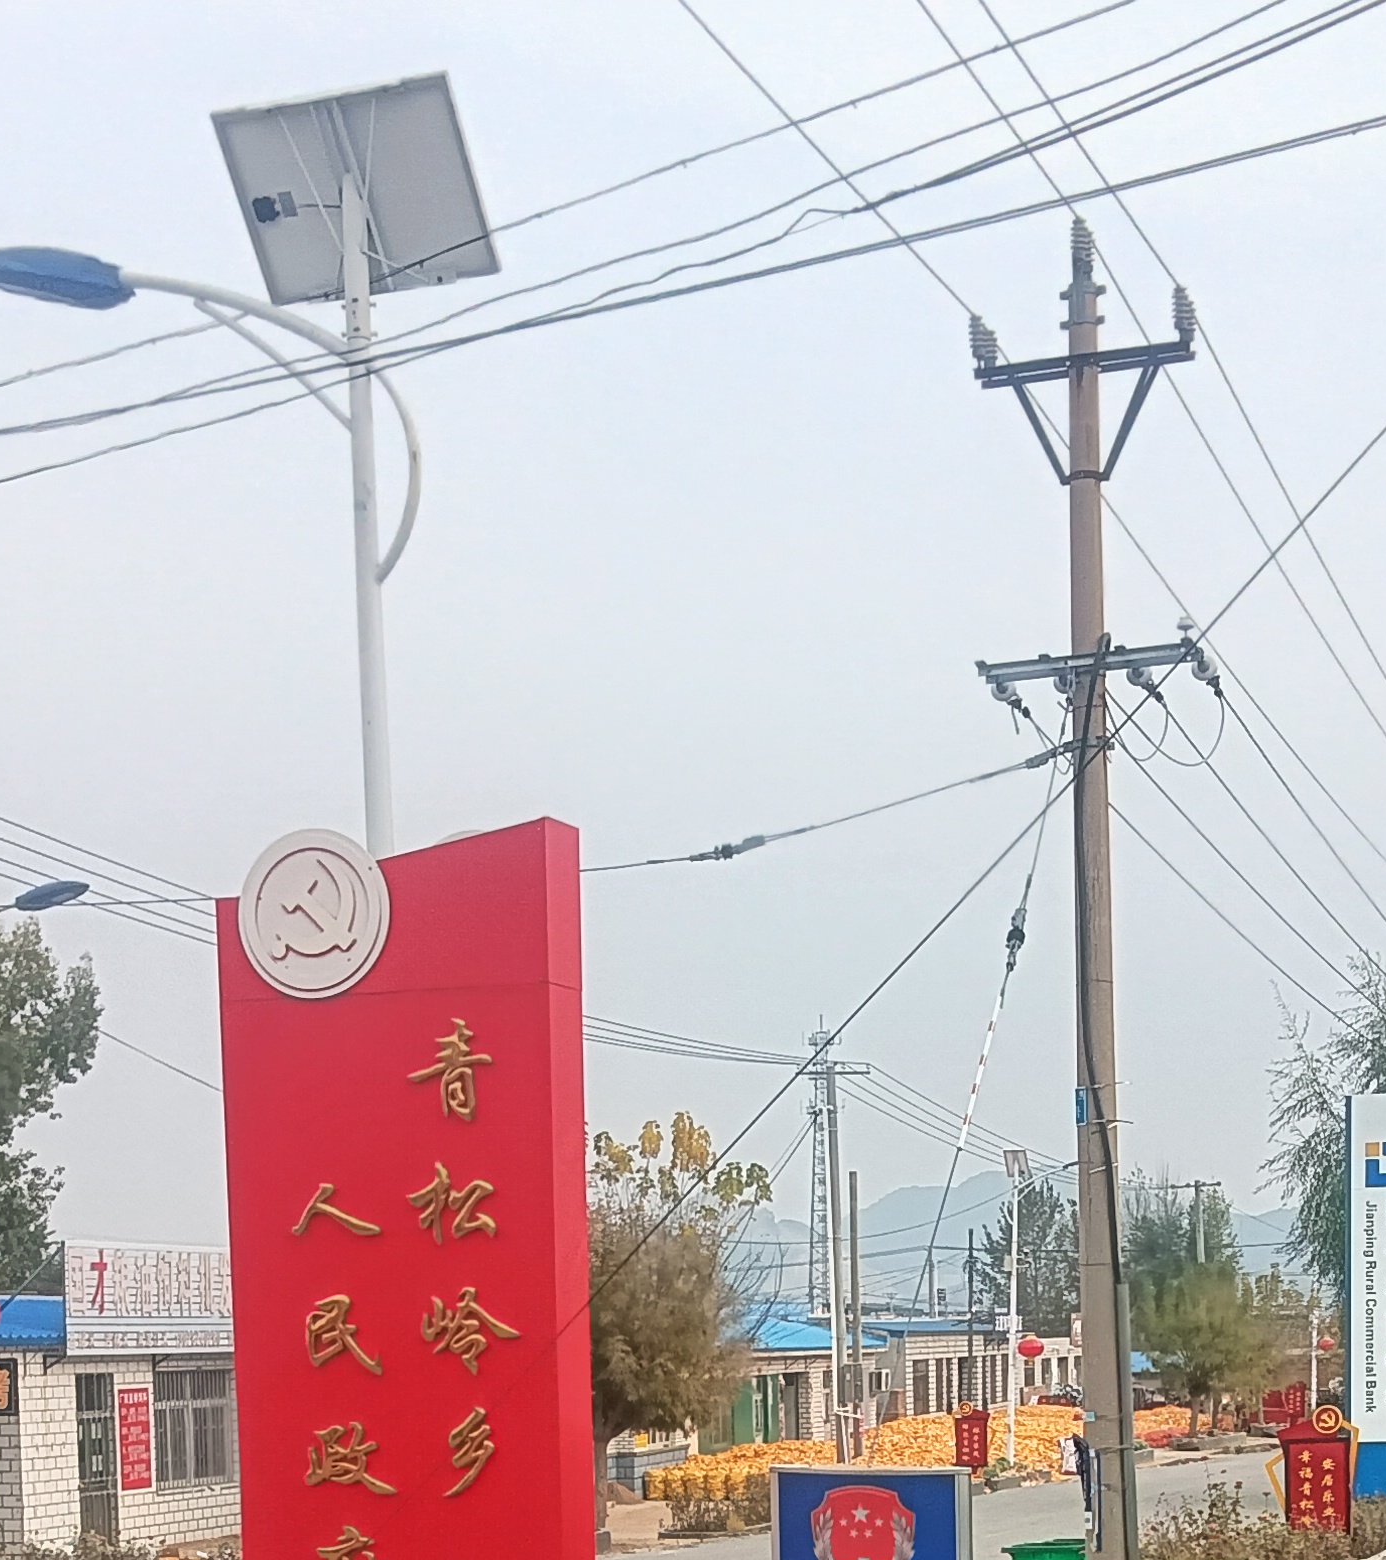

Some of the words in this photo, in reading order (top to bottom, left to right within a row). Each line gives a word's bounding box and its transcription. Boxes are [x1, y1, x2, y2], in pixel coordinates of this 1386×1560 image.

[407, 1017, 522, 1498] 青松岭乡
[1363, 1200, 1377, 1258] Jianping
[1366, 1261, 1377, 1295] Rural
[1366, 1299, 1377, 1377] Commercial
[1366, 1380, 1377, 1413] Bank
[1297, 1450, 1315, 1528] 幸福青松岭
[1320, 1458, 1337, 1518] 安居乐业
